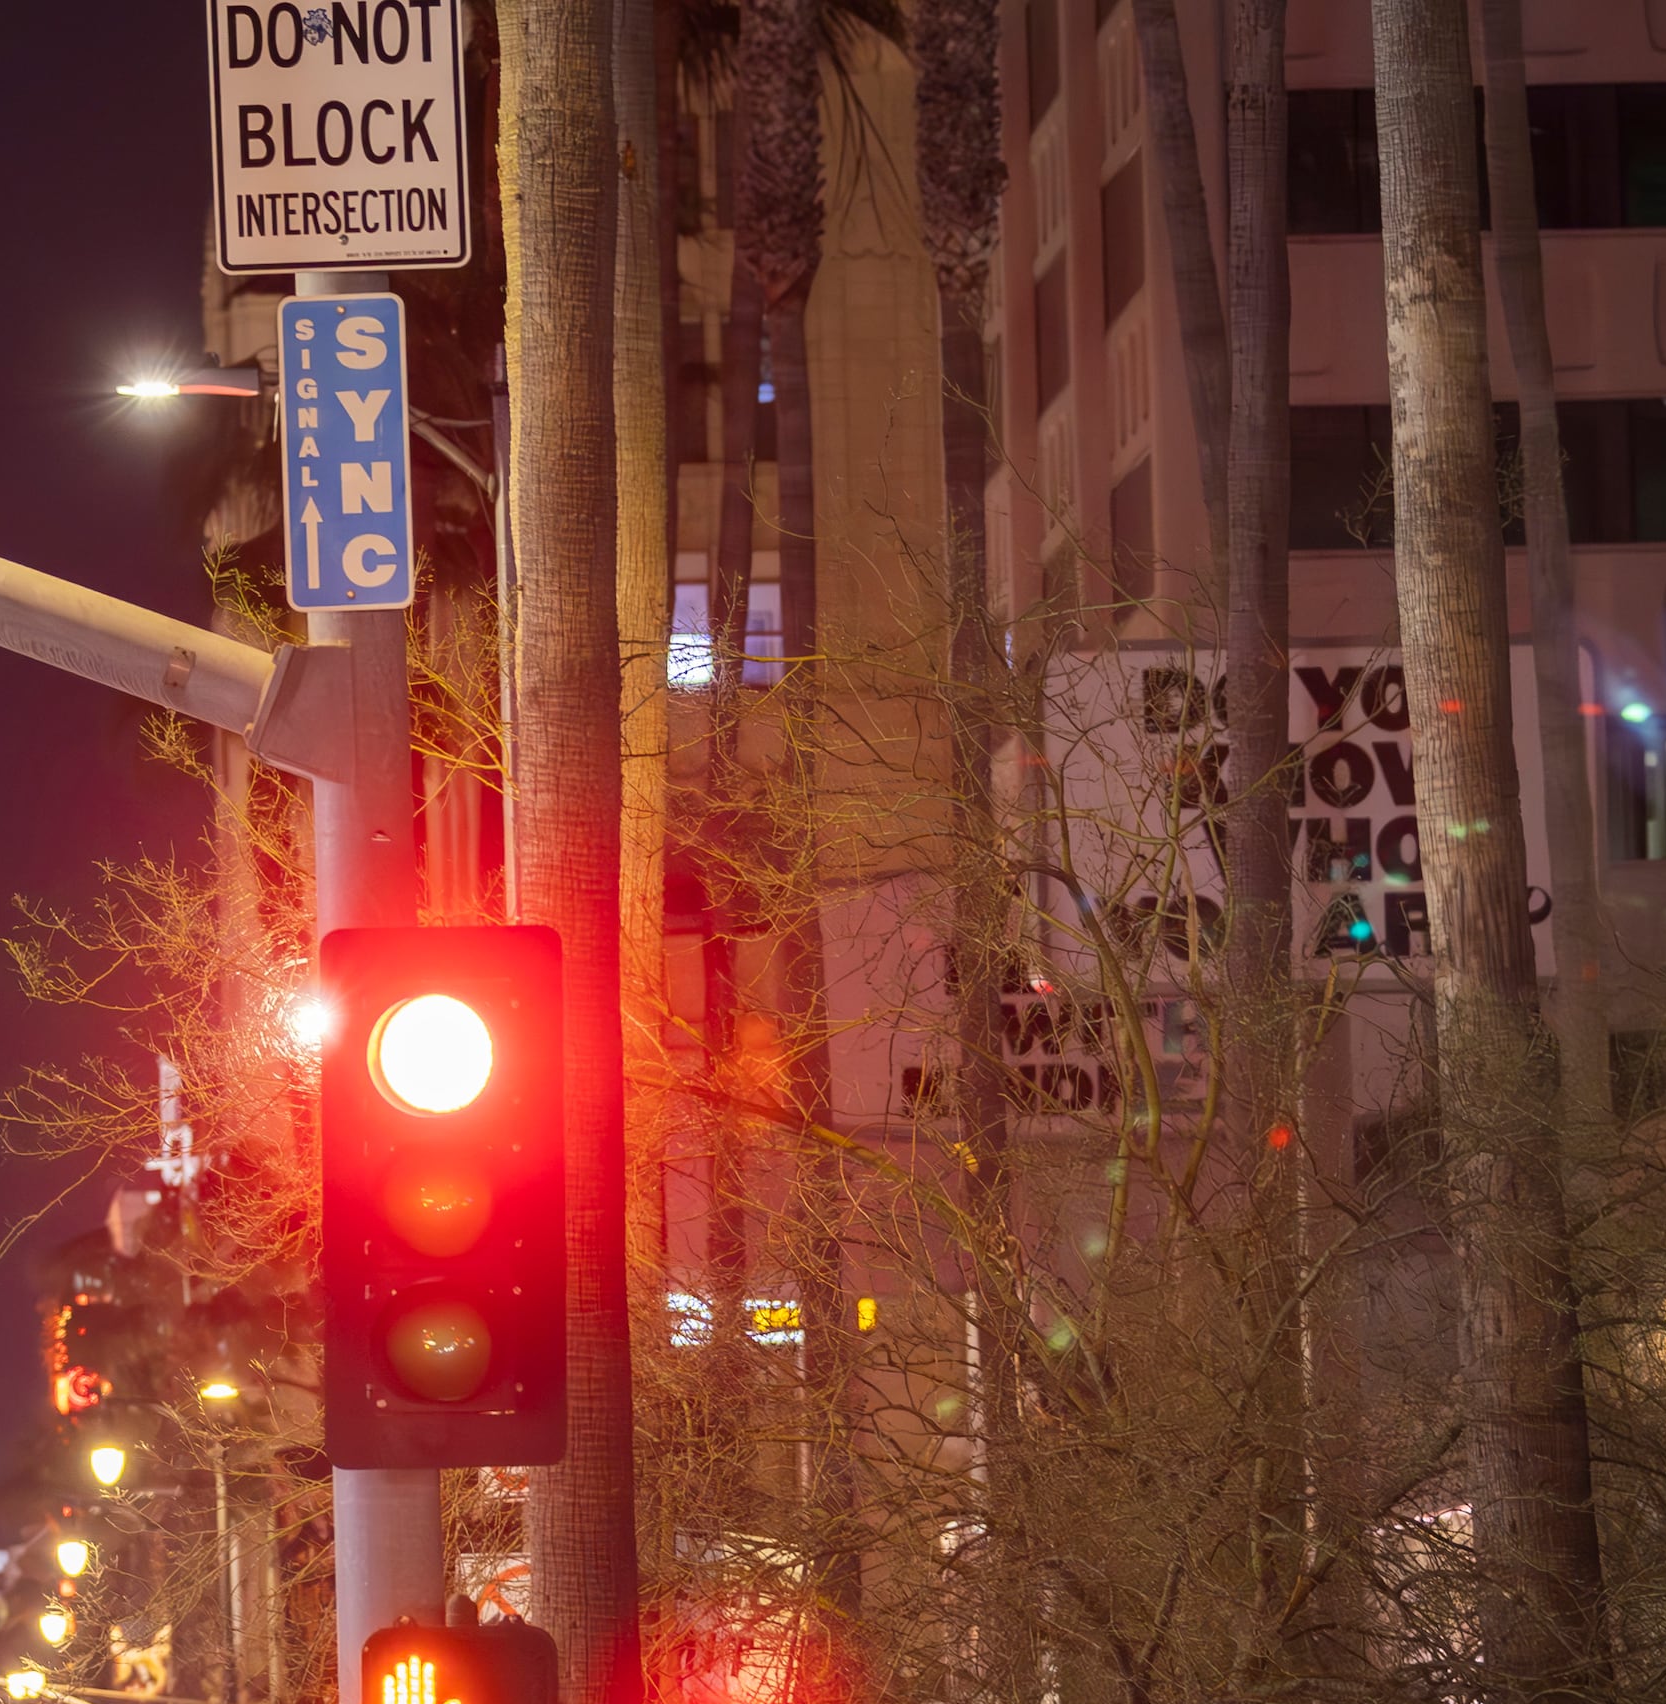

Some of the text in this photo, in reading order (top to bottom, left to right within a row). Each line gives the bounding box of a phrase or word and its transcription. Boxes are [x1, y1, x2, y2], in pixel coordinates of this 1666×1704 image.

[227, 0, 441, 69] DO NOT
[239, 98, 439, 169] BLOCK
[237, 187, 448, 238] INTERSECTION
[294, 317, 322, 488] SIGNAL
[335, 316, 399, 589] SYNC
